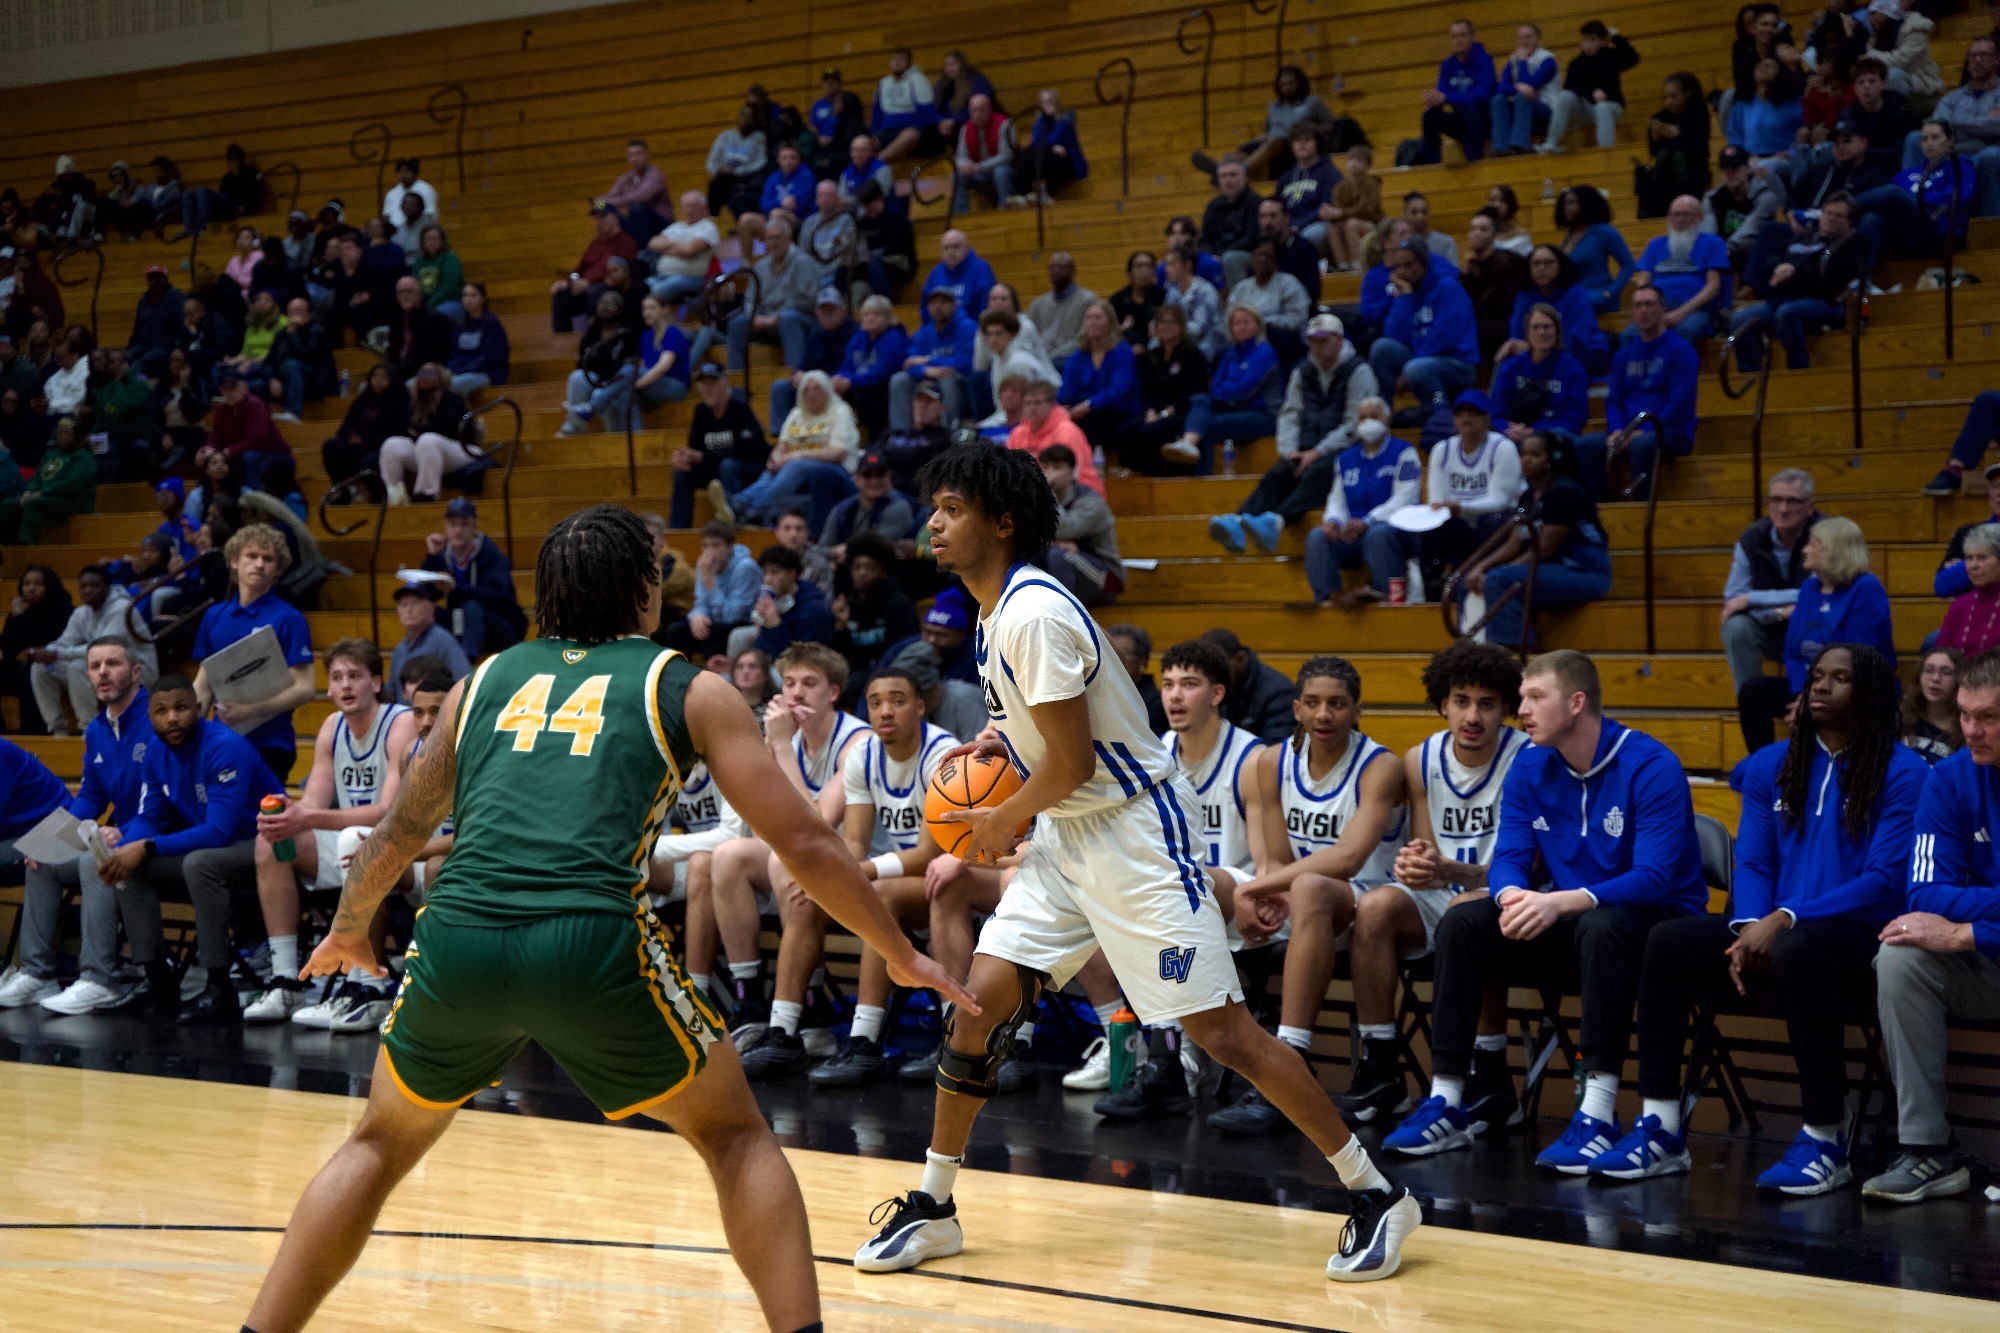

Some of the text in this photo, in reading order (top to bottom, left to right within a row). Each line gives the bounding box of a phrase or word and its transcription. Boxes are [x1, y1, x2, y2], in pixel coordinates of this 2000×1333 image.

[494, 673, 613, 757] 44
[678, 796, 718, 820] GVS
[1443, 804, 1494, 832] GVSU
[1159, 946, 1197, 984] GV
